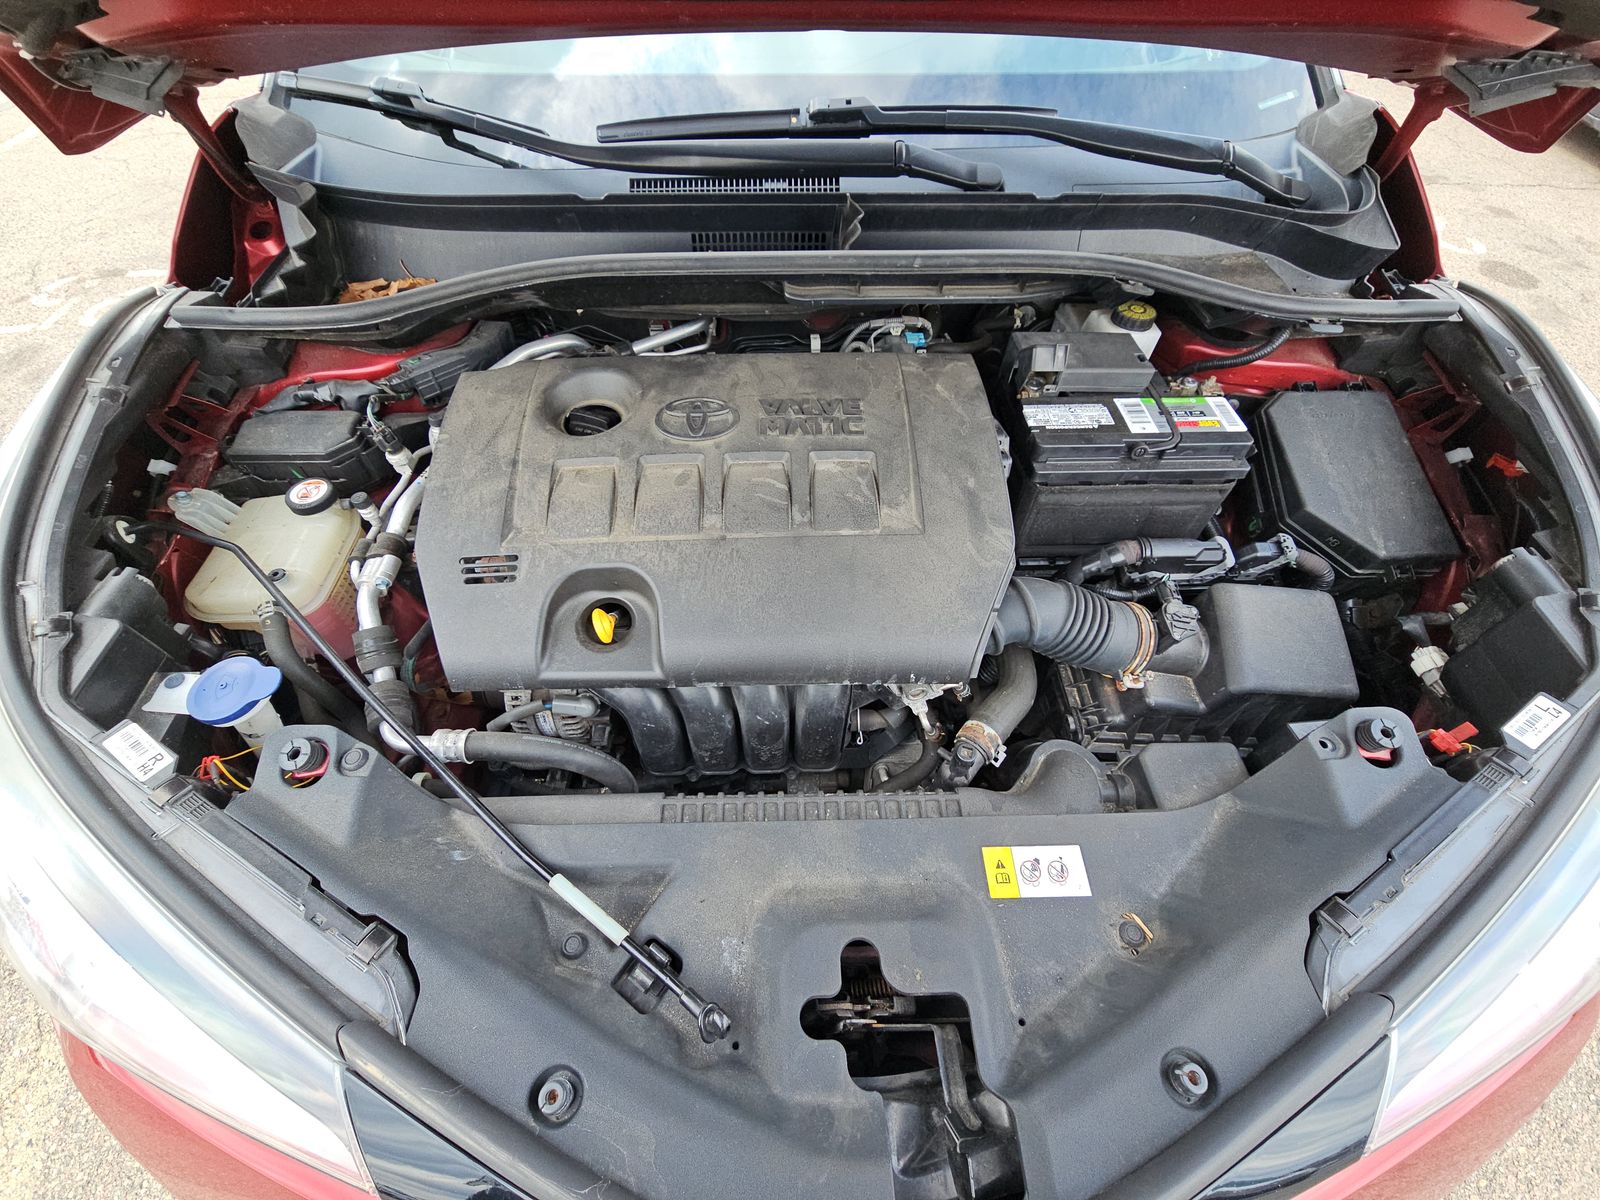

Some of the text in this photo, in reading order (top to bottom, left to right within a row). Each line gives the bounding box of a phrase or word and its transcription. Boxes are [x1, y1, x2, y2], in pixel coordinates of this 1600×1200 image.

[758, 416, 865, 436] MATIC
[1534, 704, 1551, 713] L
[147, 752, 165, 767] R
